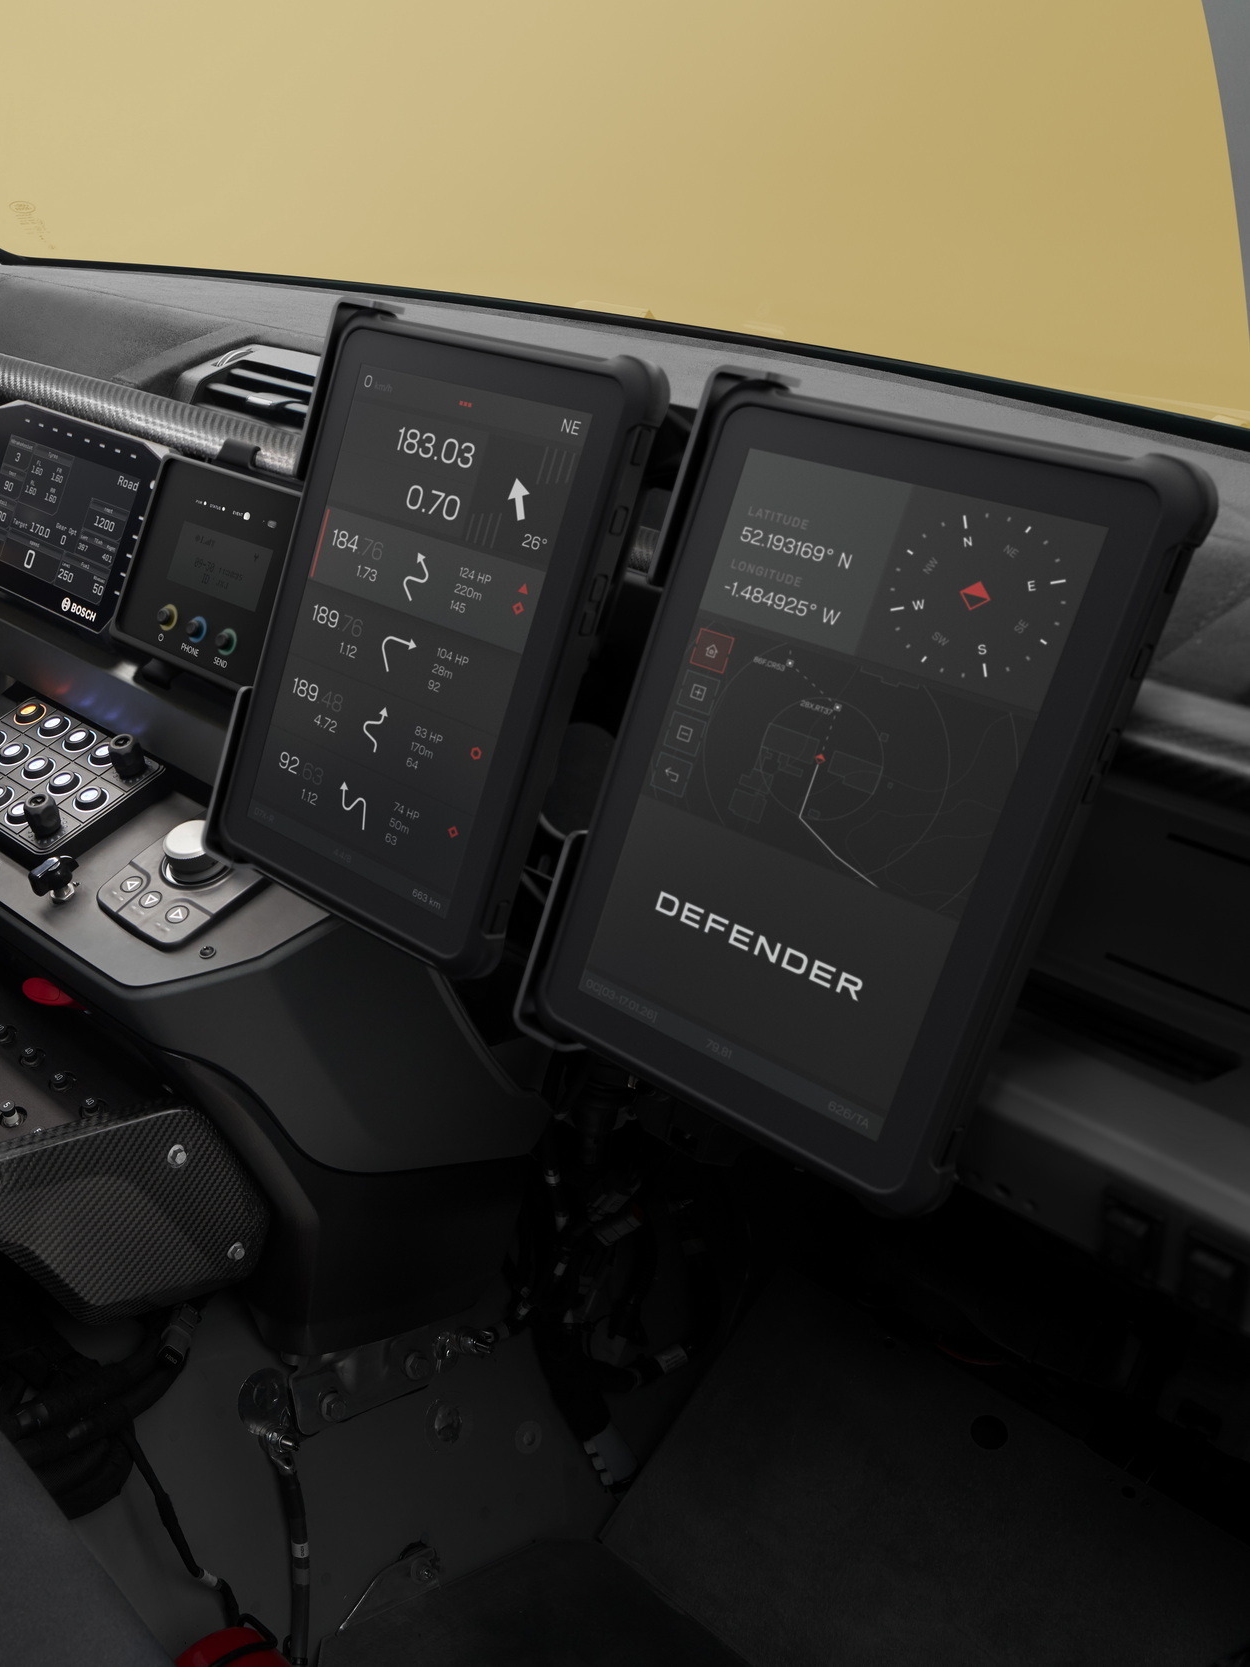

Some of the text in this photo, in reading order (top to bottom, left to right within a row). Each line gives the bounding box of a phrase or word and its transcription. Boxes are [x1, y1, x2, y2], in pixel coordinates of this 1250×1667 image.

[363, 374, 394, 395] 0 km/h
[560, 418, 583, 436] NE
[396, 426, 476, 469] 183.03
[14, 452, 21, 463] 3
[2, 480, 15, 493] 90
[116, 475, 140, 492] Road
[406, 484, 462, 522] 0.70
[93, 515, 116, 534] 1200
[747, 505, 810, 531] LATITUDE
[29, 522, 51, 540] 170.0
[60, 535, 67, 546] 0
[332, 528, 384, 563] 184.76
[521, 533, 549, 552] 26°
[739, 525, 853, 572] 52.193169° N
[962, 536, 973, 549] N
[23, 550, 36, 569] 0
[1002, 543, 1020, 560] NE
[356, 564, 379, 583] 1.73
[730, 558, 803, 589] LONGITUDE
[922, 556, 940, 576] NW
[57, 568, 74, 584] 250
[459, 566, 492, 586] 124 HP
[92, 582, 106, 597] 50
[453, 584, 484, 602] 220m
[1027, 580, 1038, 593] E
[70, 602, 97, 622] BOSCH
[449, 600, 468, 616] 145
[912, 599, 926, 612] W
[311, 604, 364, 639] 189.76
[822, 607, 841, 628] W
[1014, 618, 1031, 636] SE
[930, 630, 950, 648] SW
[180, 642, 229, 670] PHONE SEND
[339, 642, 358, 660] 1.12
[436, 647, 470, 667] 104 HP
[977, 643, 987, 656] S
[431, 664, 454, 680] 28m
[291, 677, 344, 714] 189.48
[427, 680, 441, 694] 92
[314, 713, 338, 735] 4.72
[414, 725, 445, 746] 83 HP
[410, 741, 435, 761] 170m
[406, 757, 420, 771] 64
[301, 788, 319, 806] 1.12
[393, 801, 421, 821] 74 HP
[389, 818, 410, 836] 50m
[384, 833, 398, 847] 63
[411, 888, 443, 911] 663 km
[654, 891, 864, 1002] DEFENDER
[3, 1101, 11, 1109] 5
